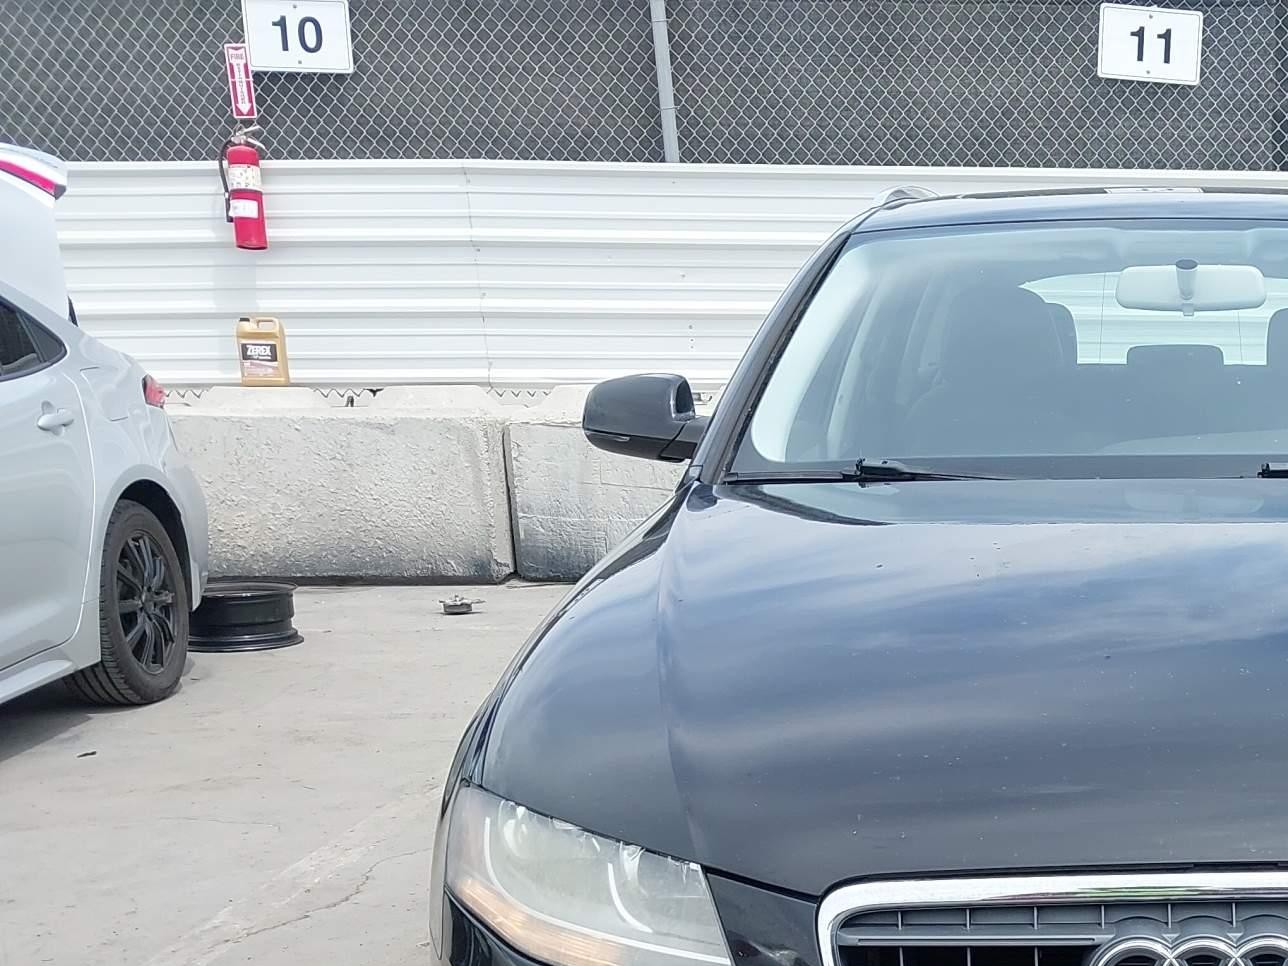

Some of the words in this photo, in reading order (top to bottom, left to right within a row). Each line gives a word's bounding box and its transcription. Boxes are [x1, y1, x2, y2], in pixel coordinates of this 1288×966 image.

[272, 15, 323, 53] 10
[1130, 26, 1171, 64] 11
[246, 345, 272, 355] ZEREX
